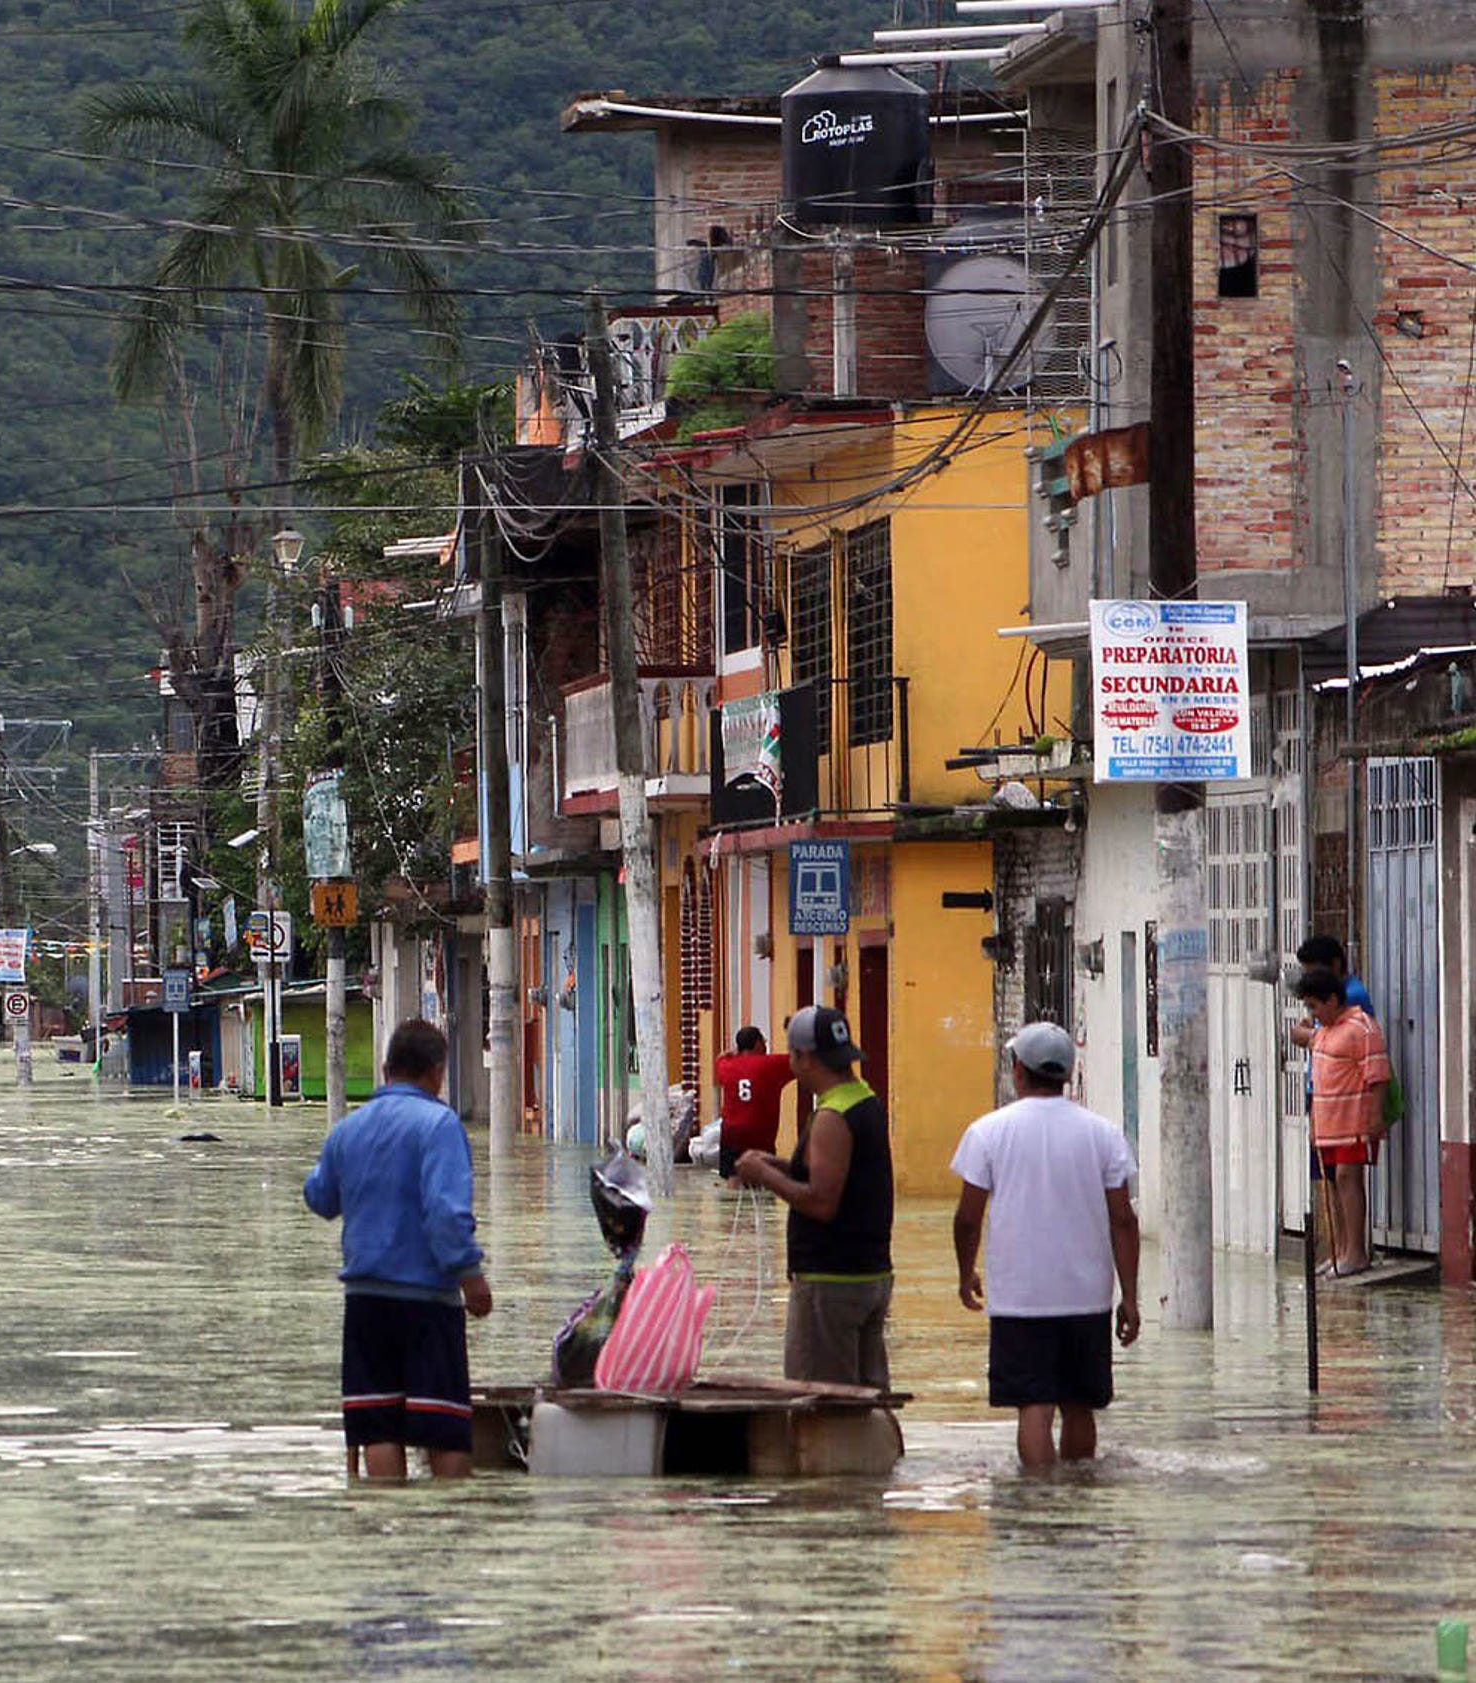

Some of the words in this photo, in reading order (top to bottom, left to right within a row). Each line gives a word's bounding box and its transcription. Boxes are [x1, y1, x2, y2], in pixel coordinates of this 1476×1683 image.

[813, 121, 873, 140] ROTOPLAS
[1101, 646, 1237, 664] PREPARATORIA
[1100, 676, 1239, 694] SECUNDARIA
[1194, 696, 1239, 705] MESES
[1112, 735, 1140, 754] TEL.
[1143, 735, 1174, 755] (754)
[1177, 735, 1233, 753] 474-2441
[792, 844, 844, 859] PARADA
[794, 909, 848, 921] ASCENSO
[738, 1079, 752, 1101] 6
